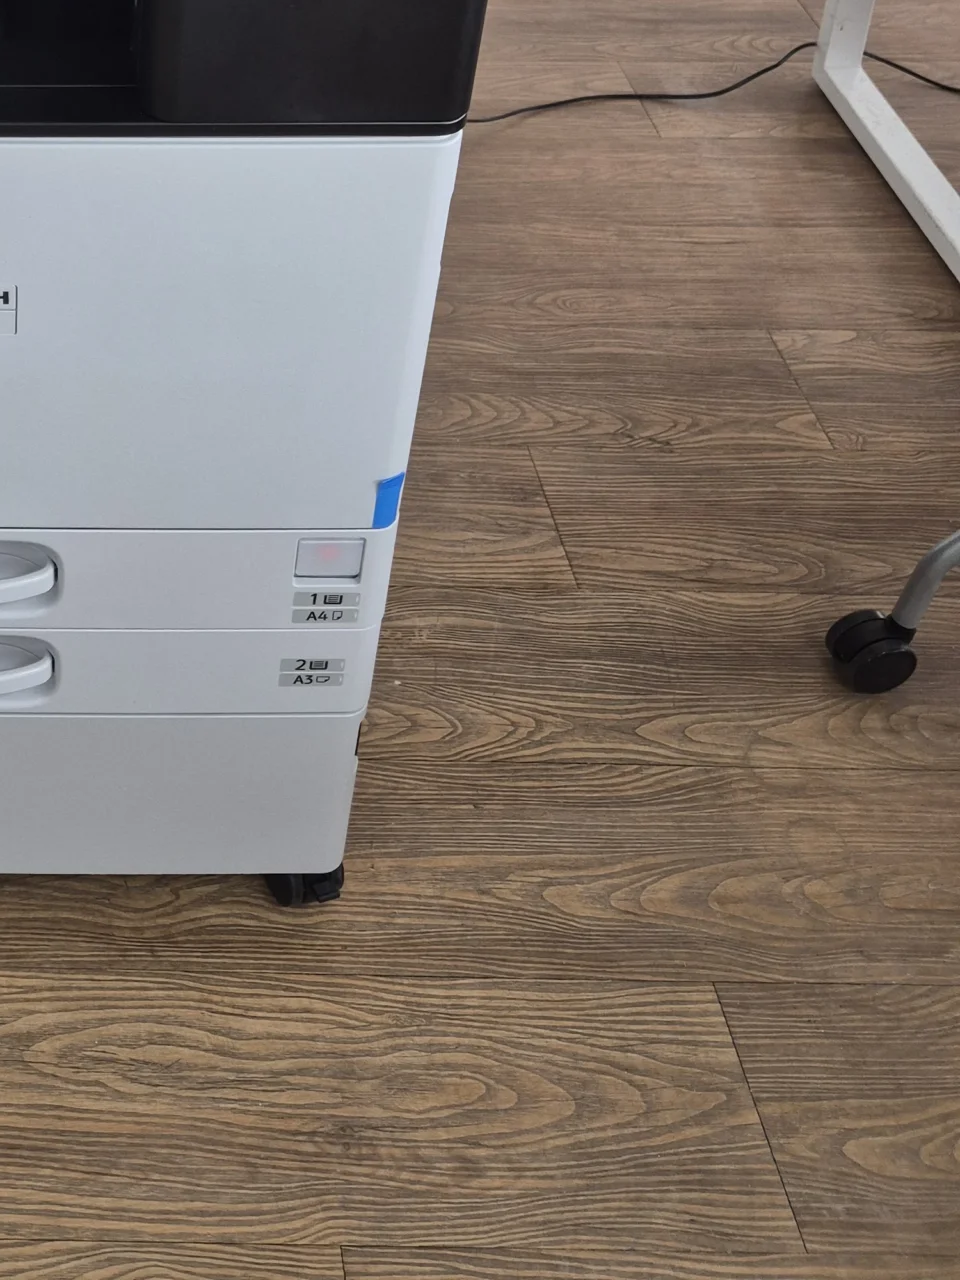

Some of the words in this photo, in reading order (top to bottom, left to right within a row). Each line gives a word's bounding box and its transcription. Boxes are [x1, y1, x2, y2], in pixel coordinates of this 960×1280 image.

[310, 593, 318, 605] 1
[306, 611, 328, 621] A4
[294, 659, 307, 671] 2
[293, 675, 313, 684] A3
